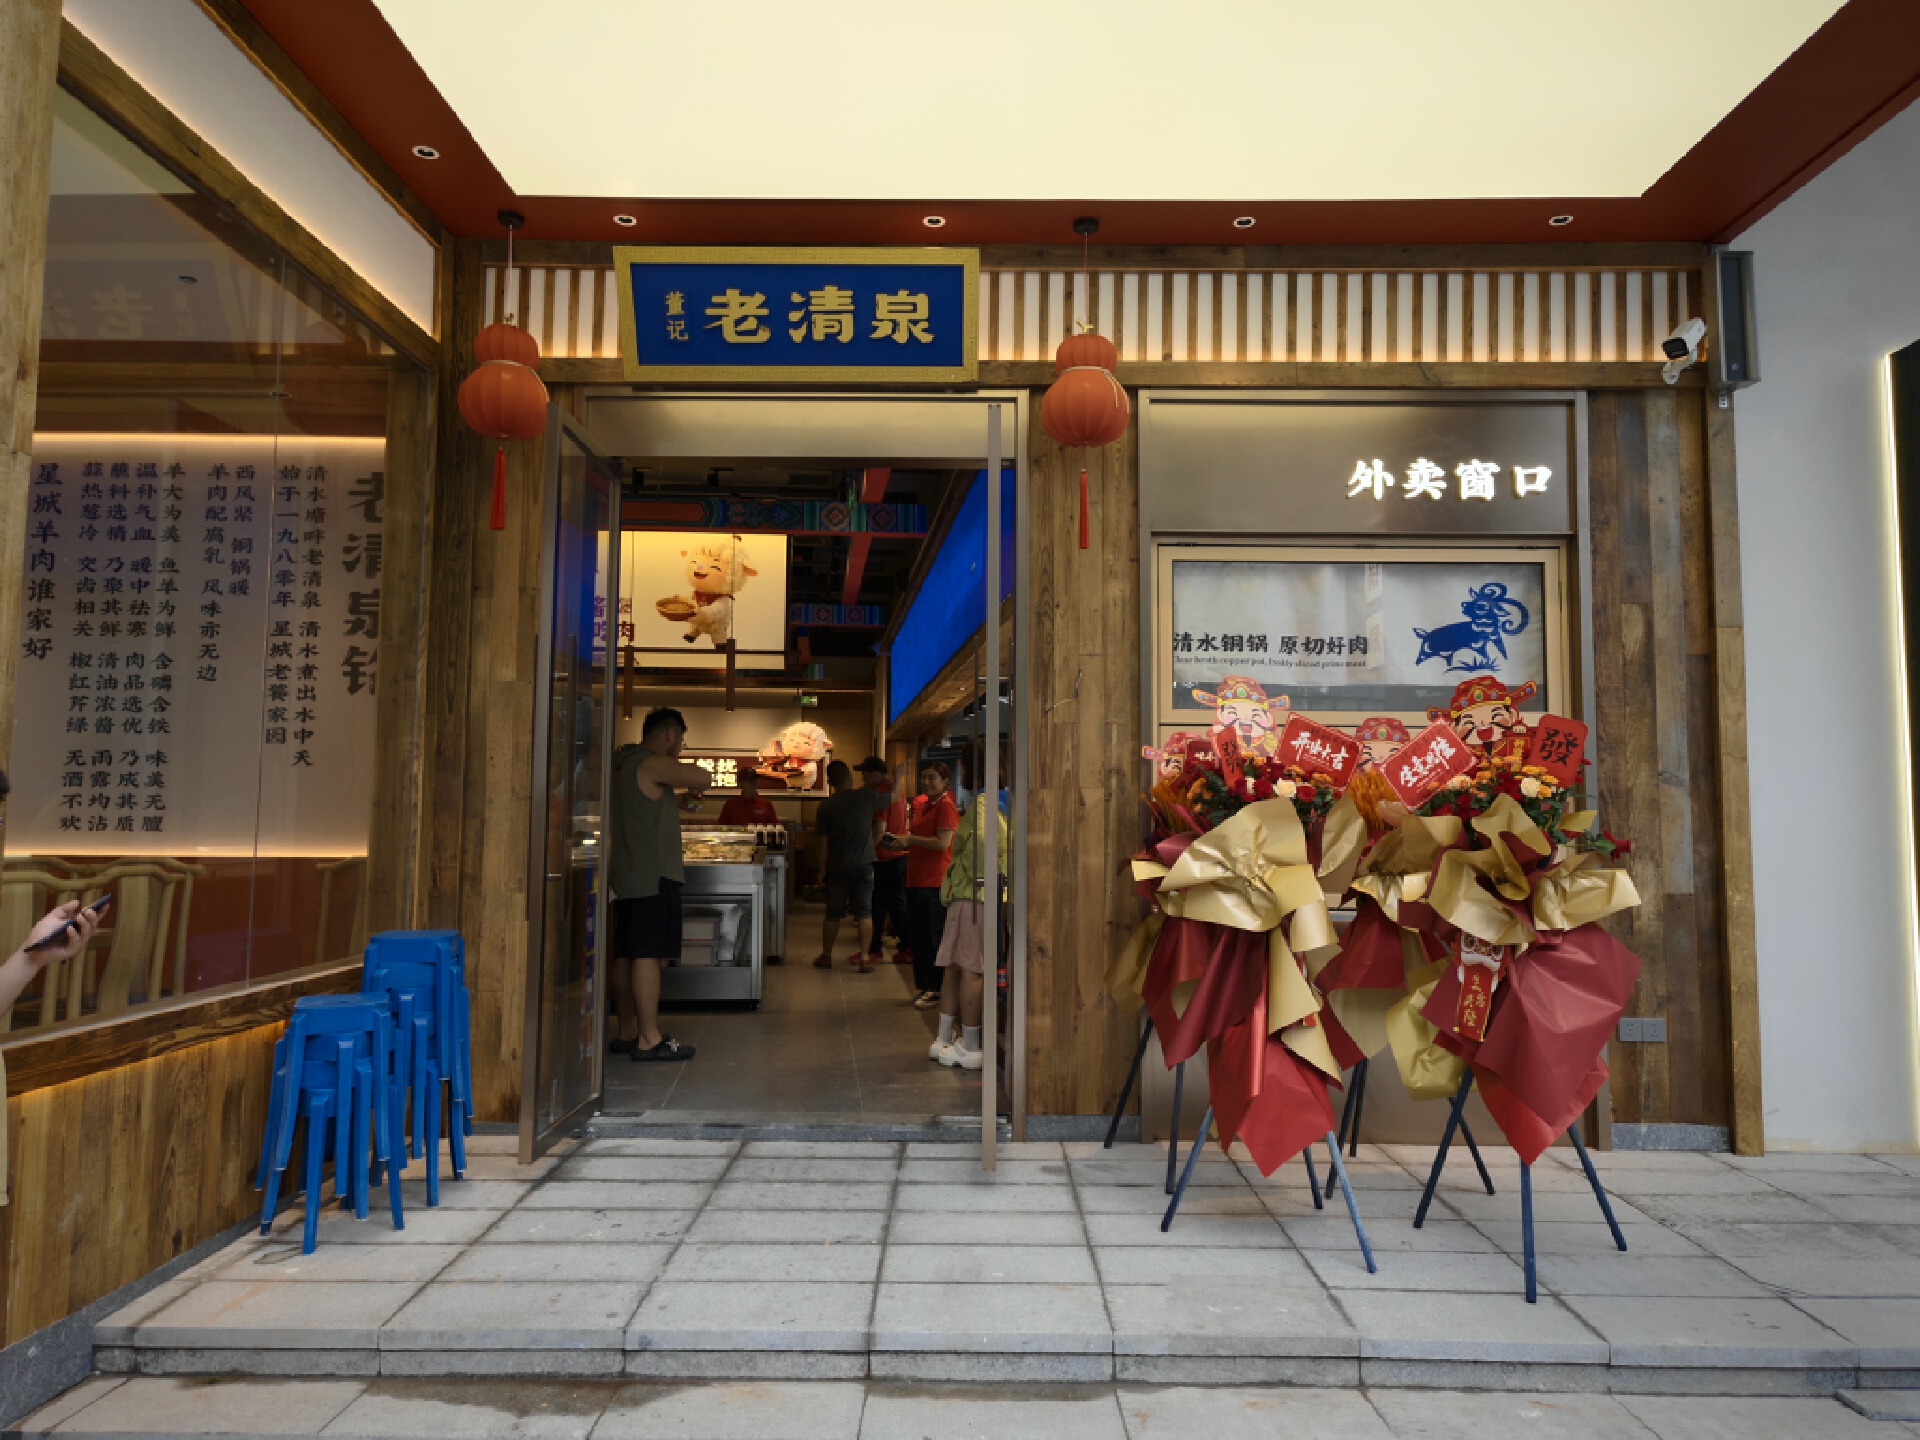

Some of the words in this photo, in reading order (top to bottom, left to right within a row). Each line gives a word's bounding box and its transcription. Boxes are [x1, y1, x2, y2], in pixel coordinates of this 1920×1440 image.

[666, 290, 689, 342] 董记
[703, 285, 935, 345] 老清泉
[130, 462, 159, 541] 温补气血
[159, 461, 187, 543] 羊大为美
[201, 462, 231, 565] 羊肉配腐乳
[232, 464, 256, 522] 西风紧
[1346, 457, 1553, 501] 外卖窗口
[22, 462, 63, 660] 星城羊肉谁家好
[227, 537, 253, 597] 铜锅暖
[271, 464, 302, 608] 始于一九八零年
[299, 464, 328, 609] 清水塘畔老清泉
[154, 556, 180, 638] 鱼羊为鲜
[196, 578, 223, 682] 风味亦无边
[1173, 632, 1269, 654] 清水铜锅
[1279, 635, 1369, 656] 原切好肉
[291, 620, 322, 768] 清水煮出水中天
[1539, 726, 1580, 766] 發
[58, 749, 87, 832] 无酒不欢
[88, 749, 113, 832] 雨露均沾
